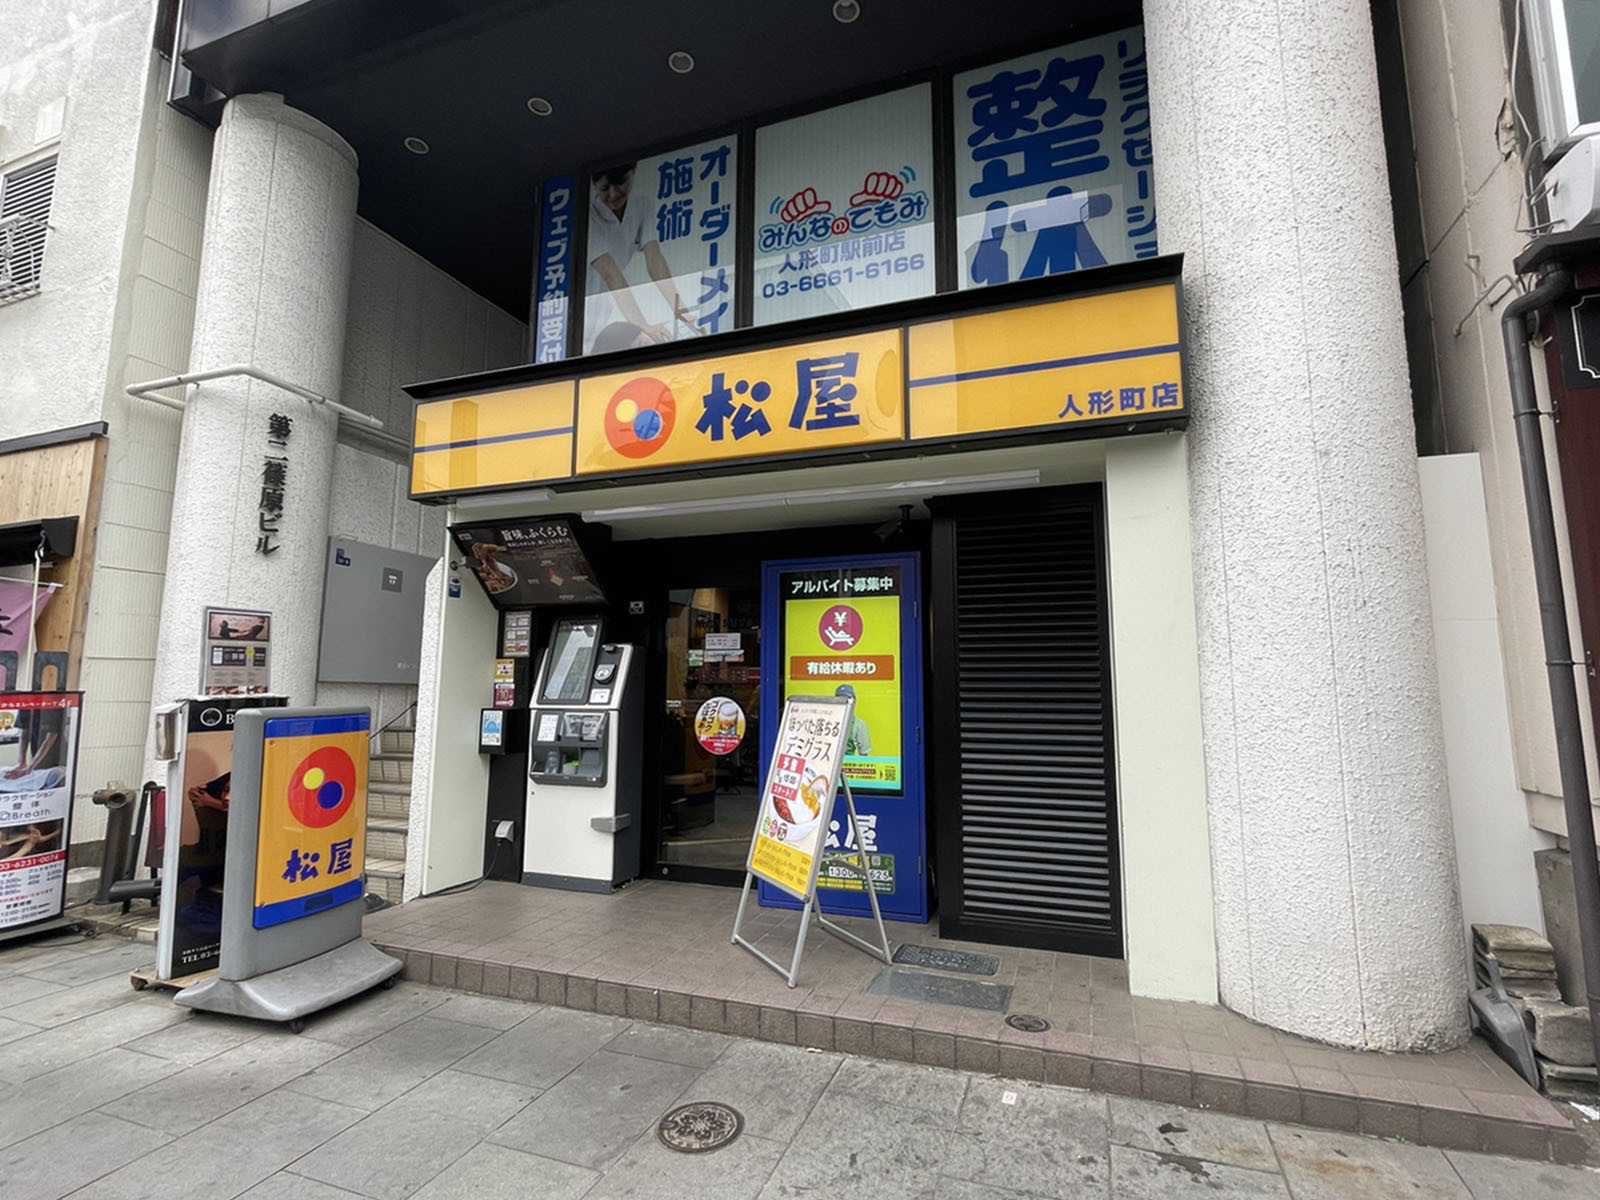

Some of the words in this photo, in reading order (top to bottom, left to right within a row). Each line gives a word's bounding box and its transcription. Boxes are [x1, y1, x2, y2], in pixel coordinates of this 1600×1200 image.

[656, 158, 694, 243] 施術
[760, 193, 927, 252] みんなのてもみ
[539, 187, 571, 363] ウェブ予約受付
[779, 230, 906, 274] 人形町駅前店
[762, 253, 925, 299] 03-6661-6166
[695, 351, 862, 442] 松屋
[1059, 381, 1180, 419] 人形町店
[791, 576, 894, 595] アルバイト募集中
[806, 660, 877, 676] 有給休暇あり
[282, 837, 353, 884] 松屋
